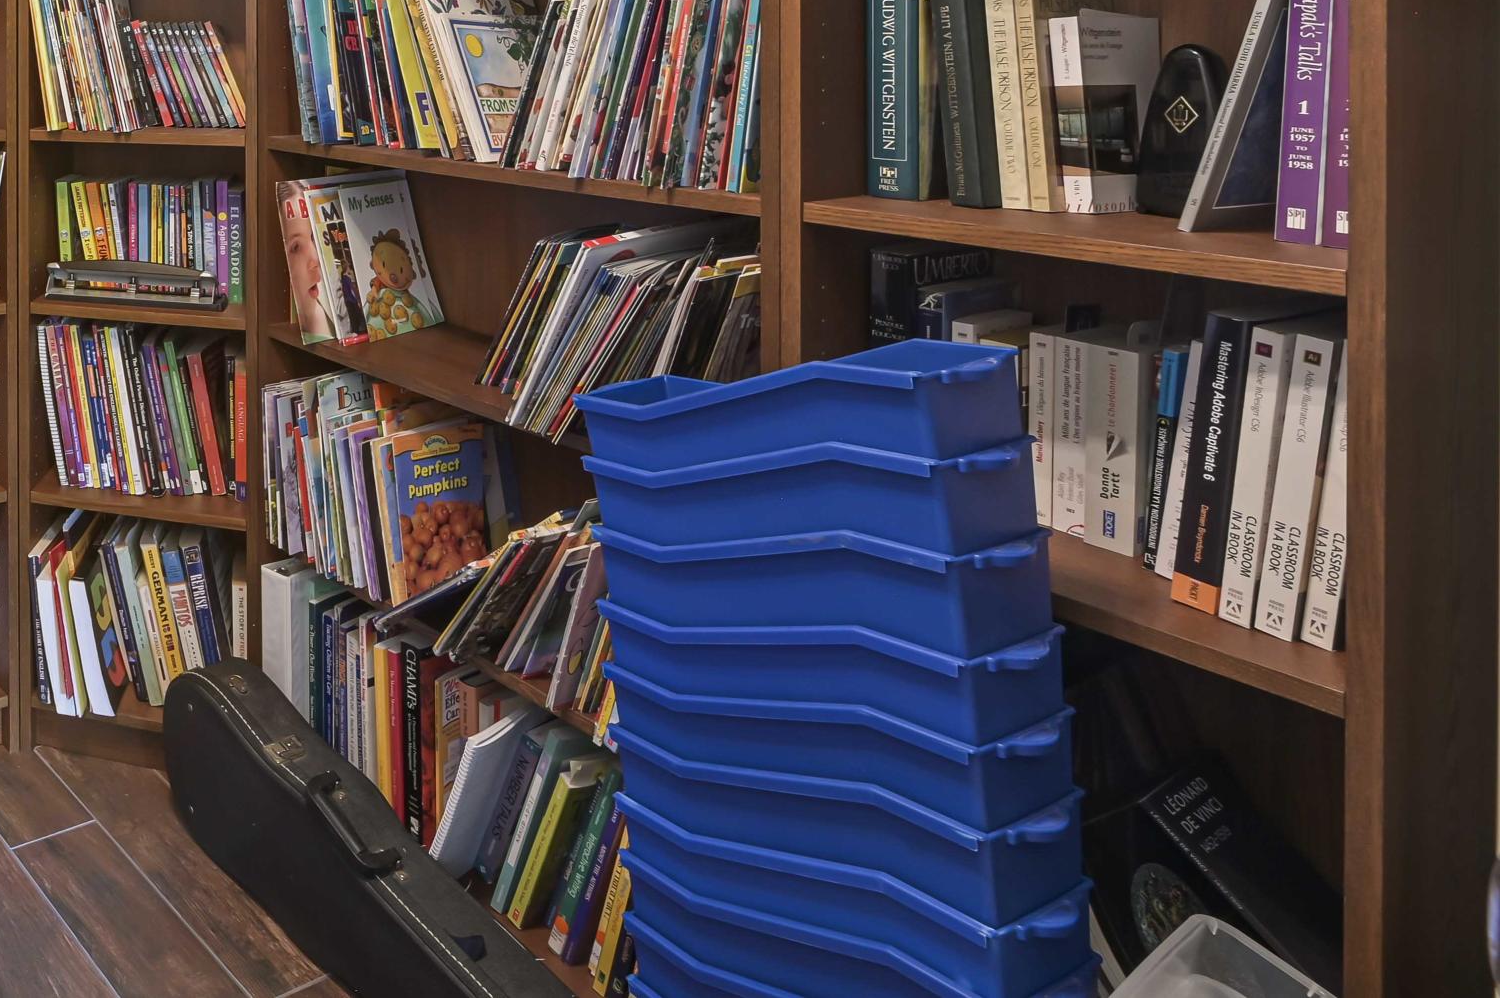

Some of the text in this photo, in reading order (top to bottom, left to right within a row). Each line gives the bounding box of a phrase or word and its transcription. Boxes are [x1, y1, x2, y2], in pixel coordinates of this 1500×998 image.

[938, 4, 951, 39] A LIFE
[994, 19, 1013, 112] THE FALSE PRISON
[1227, 9, 1262, 95] SUSILA BUDHI DHARMA
[1294, 40, 1324, 82] Talks
[480, 98, 509, 114] FROM
[881, 50, 895, 151] WITTGENSTEIN
[1297, 99, 1310, 115] 1
[1289, 133, 1316, 143] 1957
[1290, 126, 1314, 134] JUNE
[880, 178, 897, 186] FREE
[1287, 160, 1314, 170] 1958
[348, 194, 394, 213] My Senses
[228, 205, 244, 285] EL SOÑADOR
[49, 353, 64, 390] CALLA
[132, 367, 141, 384] Oxford
[1061, 344, 1073, 374] française
[134, 384, 143, 402] Picture
[1061, 375, 1071, 397] langue
[1061, 399, 1069, 407] de
[136, 402, 148, 427] Dictionary
[237, 401, 245, 443] LANGUAGE
[1200, 340, 1233, 482] Mastering Adobe Captivate 6
[408, 475, 468, 499] Pumpkins
[414, 458, 461, 479] Perfect
[1098, 466, 1112, 499] Donna
[1108, 471, 1122, 499] Tartt
[1225, 509, 1243, 562] IN A BOOK
[1239, 515, 1258, 578] CLASSROOM
[1280, 526, 1302, 590] CLASSROOM
[1323, 532, 1347, 597] CLASSROOM
[151, 570, 170, 624] GERMAN
[163, 633, 176, 652] FUN
[173, 589, 192, 627] PUNTOS
[152, 633, 162, 656] GERMAN
[399, 647, 422, 711] CHAMPs
[488, 753, 531, 841] NUMBER TALKS
[1164, 777, 1208, 815] LÉONARD
[1180, 796, 1224, 834] DE VINCI
[566, 832, 599, 899] Interactive Writing
[583, 843, 609, 902] ABOUT THE AUTHORS
